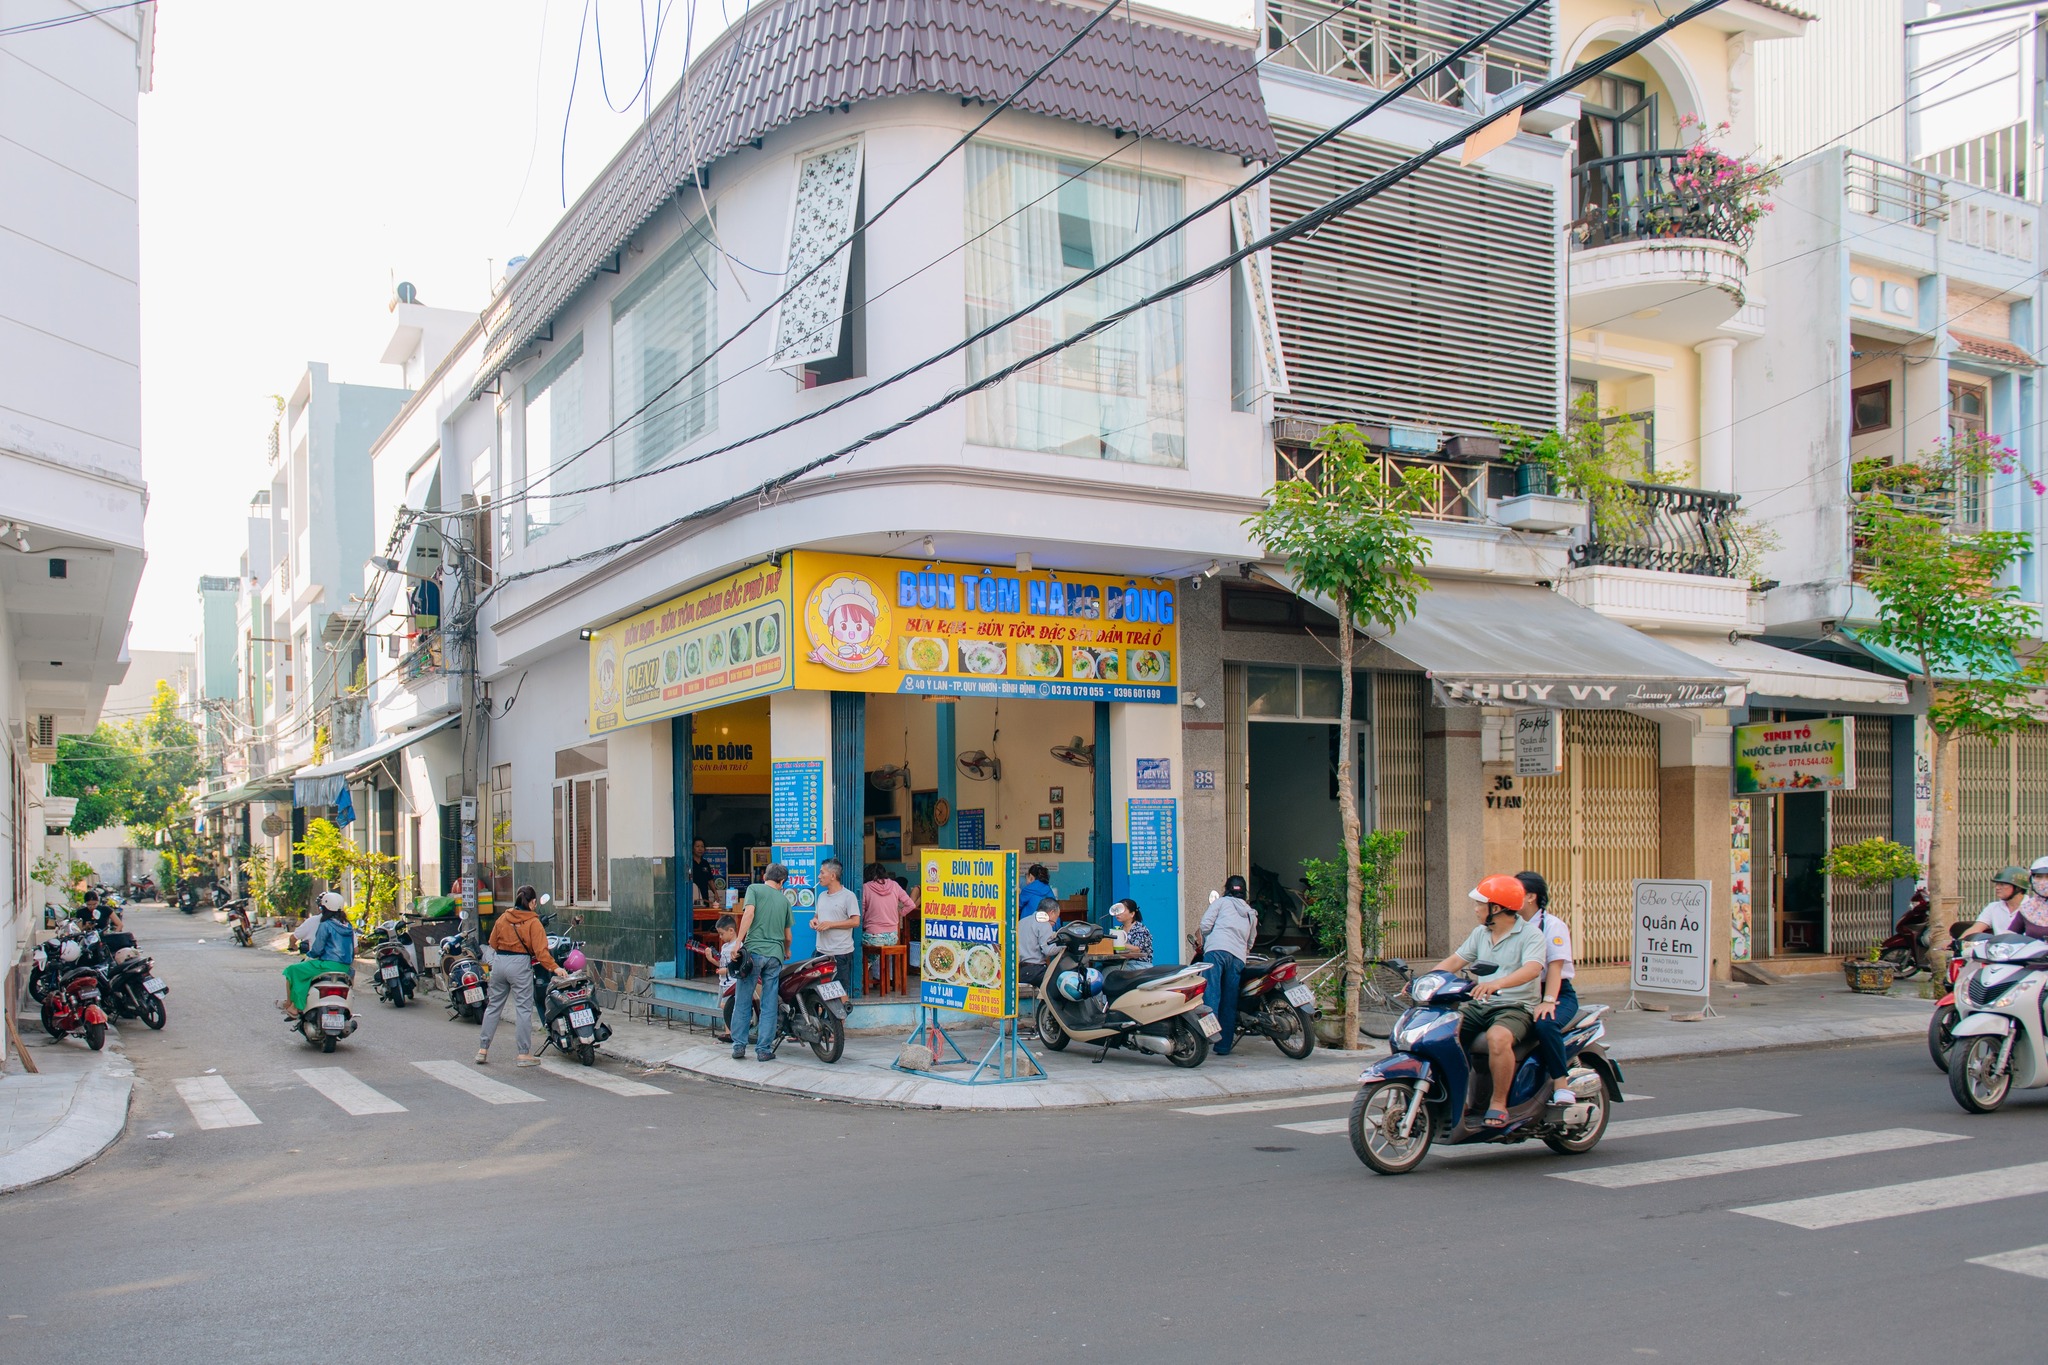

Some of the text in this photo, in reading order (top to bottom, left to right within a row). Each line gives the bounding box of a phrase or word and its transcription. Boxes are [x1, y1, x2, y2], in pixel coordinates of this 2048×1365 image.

[898, 564, 1175, 625] BÚN TÔM NÀNG BÔNG
[905, 615, 933, 633] BÚN
[937, 619, 967, 637] RẠM
[977, 618, 1004, 636] BÚN
[1008, 621, 1036, 639] TÔM
[1125, 629, 1152, 646] TRÀ
[626, 657, 660, 695] MENU
[915, 680, 925, 690] 40
[933, 680, 948, 691] LAN
[978, 680, 998, 693] NHƠN
[1002, 680, 1018, 694] BÌNH
[1051, 685, 1071, 696] 0376
[1073, 686, 1088, 697] 079
[1089, 686, 1104, 697] 055
[1444, 679, 1723, 703] THÚY VY Luxury Mobile
[1763, 723, 1812, 742] SINH TỐ
[718, 742, 753, 761] BÔNG
[1742, 739, 1836, 758] NƯỚC ÉP TRÁI CÂY
[1789, 757, 1834, 767] 0774.544.424
[1196, 771, 1214, 784] 38
[952, 858, 994, 877] BÚN TÔM
[789, 876, 806, 885] 17K
[943, 880, 999, 900] NÀNG BÔNG
[924, 900, 940, 916] BÚN
[962, 902, 980, 918] BÚN
[979, 903, 997, 919] TÔM
[1640, 889, 1703, 914] Beo Kids
[925, 921, 999, 942] BÁN CẢ NGÀY
[1642, 914, 1700, 932] Quần Áo
[1647, 937, 1693, 954] Trẻ Em
[929, 985, 937, 995] 40
[942, 987, 954, 998] LAN
